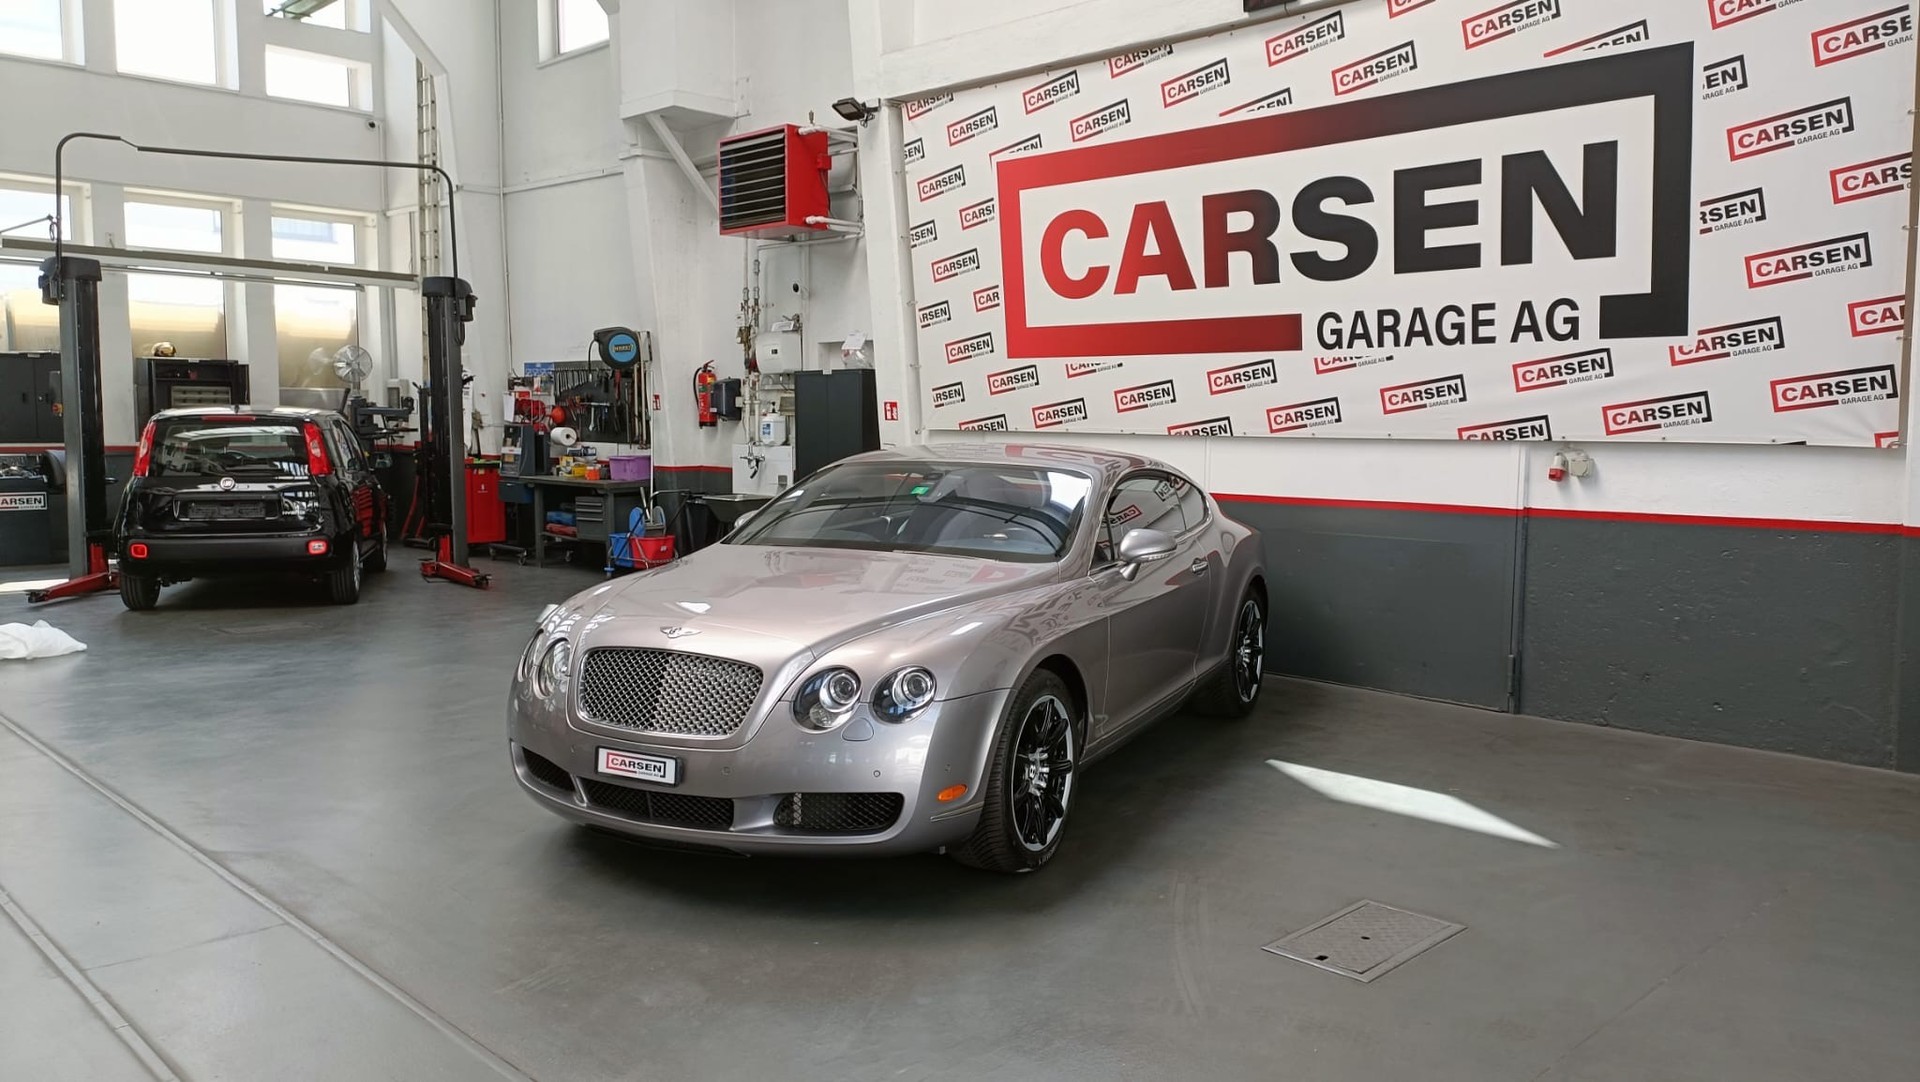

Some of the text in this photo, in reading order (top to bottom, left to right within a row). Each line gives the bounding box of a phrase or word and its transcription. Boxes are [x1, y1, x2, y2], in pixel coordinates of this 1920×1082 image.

[1471, 0, 1552, 38] CARSEN
[1517, 20, 1541, 32] GARAGE
[1272, 20, 1338, 56] CARSEN
[1339, 50, 1410, 87] CARSEN
[1029, 78, 1075, 106] CARSEN
[1168, 67, 1224, 99] CARSEN
[1725, 86, 1735, 94] AG
[952, 113, 994, 139] CARSEN
[1075, 107, 1126, 135] CARSEN
[1738, 109, 1844, 149] CARSEN
[1797, 129, 1840, 145] GARAGE AG
[922, 171, 961, 194] CARSEN
[1040, 140, 1618, 300] CARSEN
[1714, 217, 1754, 231] GARAGE AG
[936, 255, 976, 275] CARSEN
[1756, 244, 1861, 277] CARSEN
[1815, 265, 1846, 277] GARAGE
[1317, 297, 1580, 351] GARAGE AG
[950, 338, 990, 357] CARSEN
[1732, 347, 1760, 357] GARAGE
[992, 370, 1035, 389] CARSEN
[1214, 366, 1271, 387] CARSEN
[1522, 357, 1605, 382] CARSEN
[1120, 386, 1171, 406] CARSEN
[1388, 383, 1460, 406] CARSEN
[1781, 375, 1888, 402] CARSEN
[1841, 395, 1872, 405] GARAGE
[1037, 404, 1082, 422] CARSEN
[1274, 404, 1336, 425] CARSEN
[1612, 401, 1703, 426] CARSEN
[1, 497, 42, 505] ARSEN
[611, 758, 662, 773] CARSEN
